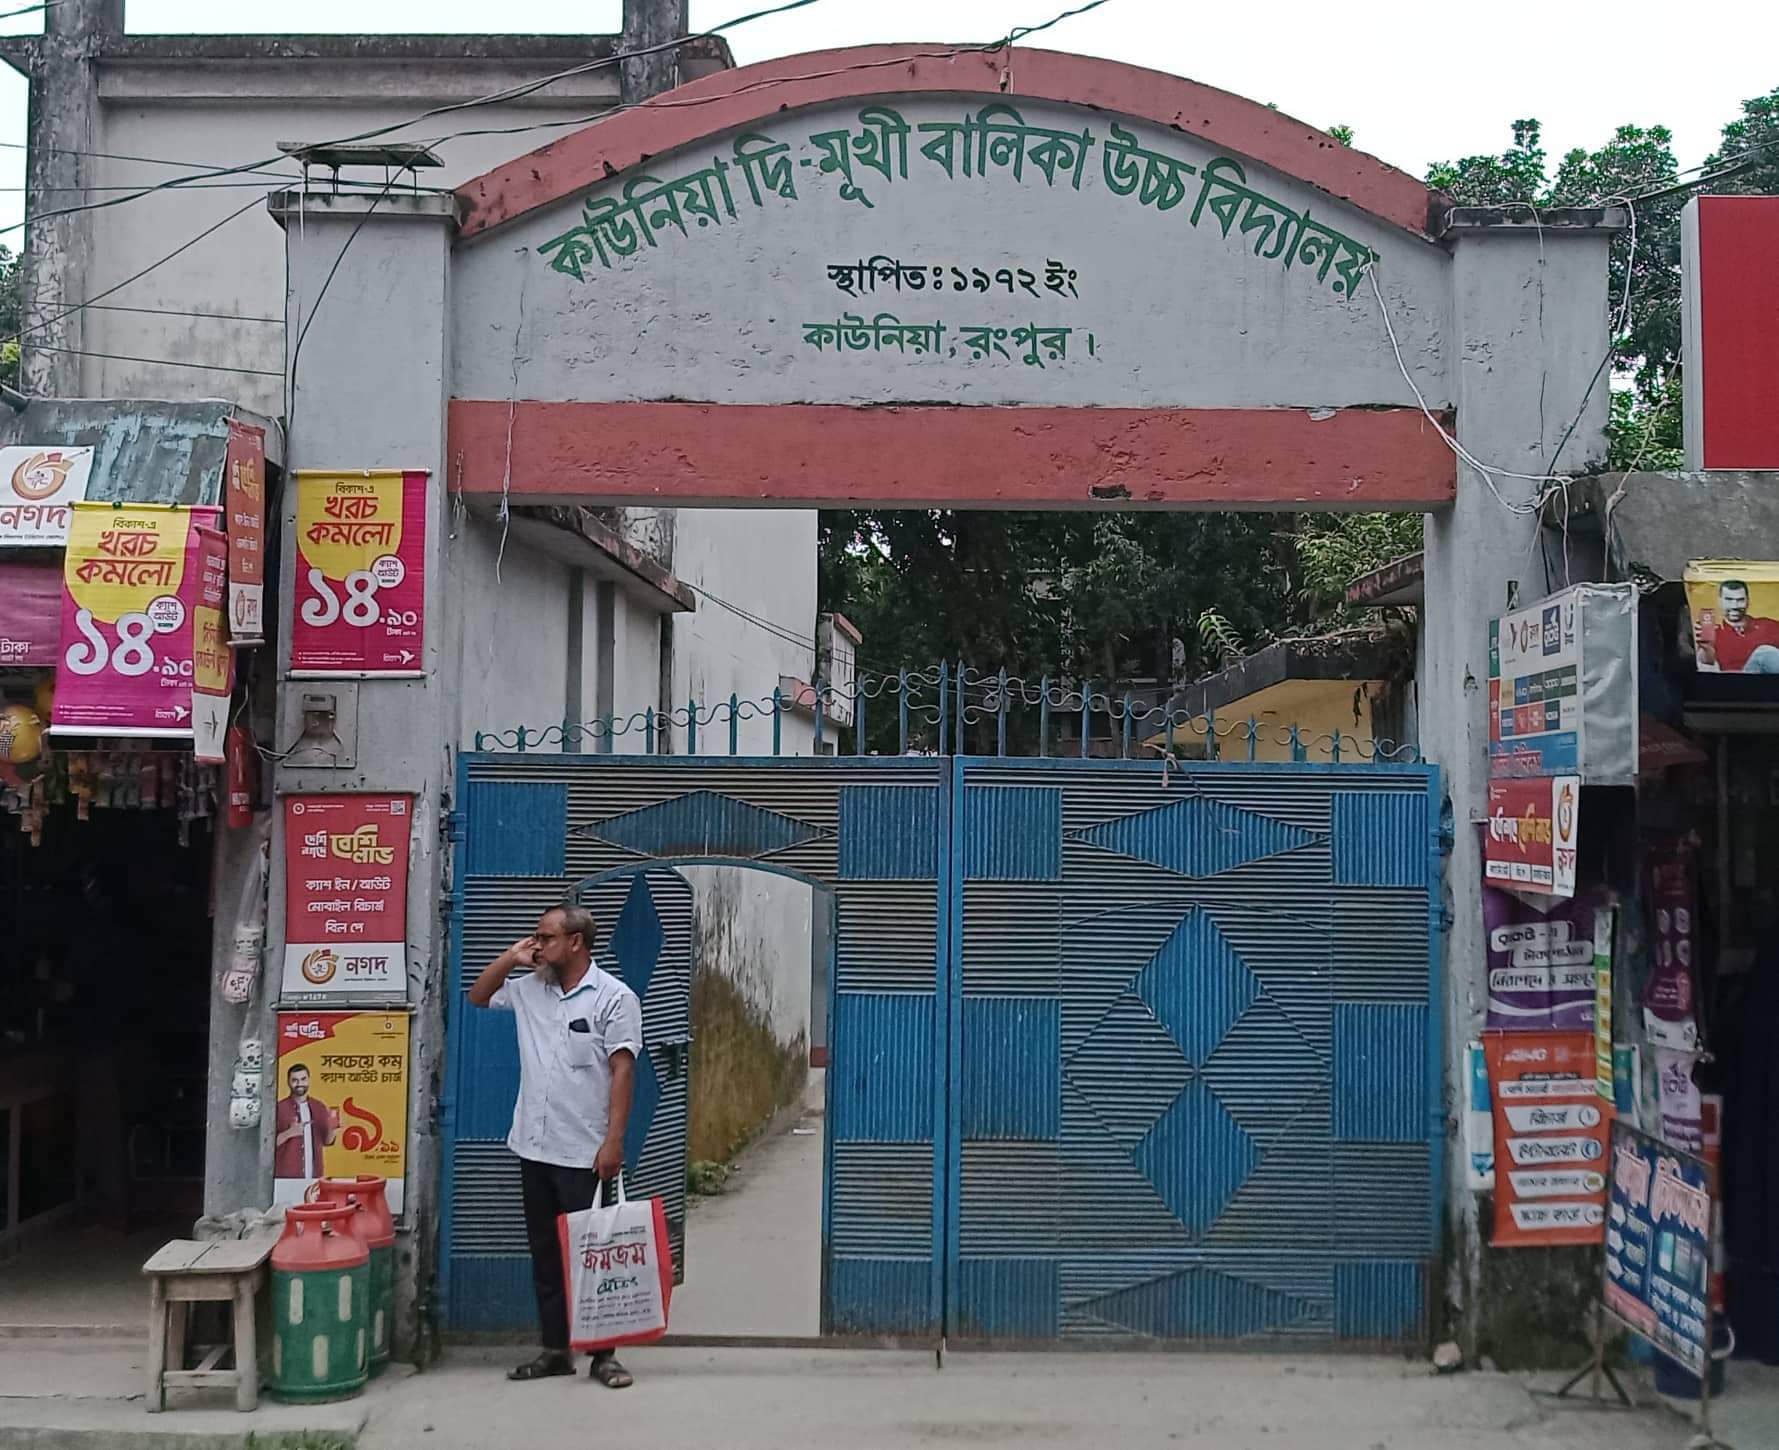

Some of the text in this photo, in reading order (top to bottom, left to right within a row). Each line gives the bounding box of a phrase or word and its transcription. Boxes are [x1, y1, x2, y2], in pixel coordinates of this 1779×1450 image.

[537, 155, 738, 284] কাউনিয়া
[918, 103, 1095, 191] বালিকা
[1102, 122, 1196, 210] উচ্চ
[1190, 156, 1380, 301] বিদ্যালয়
[0, 504, 69, 530] নগদ
[324, 496, 379, 519] খরচ
[98, 531, 160, 557] খরচ
[306, 522, 395, 547] কমলো
[76, 559, 176, 587] কমলো
[301, 567, 417, 627] ১৪.৯০
[305, 879, 332, 891] ক্যাশ
[307, 898, 352, 913] মোবাইল
[325, 919, 365, 934] বিল পে
[344, 956, 389, 976] নগদ
[321, 1054, 403, 1069] সবচেয়ে কম
[320, 1072, 346, 1083] ক্যাশ
[347, 1069, 379, 1083] আউট
